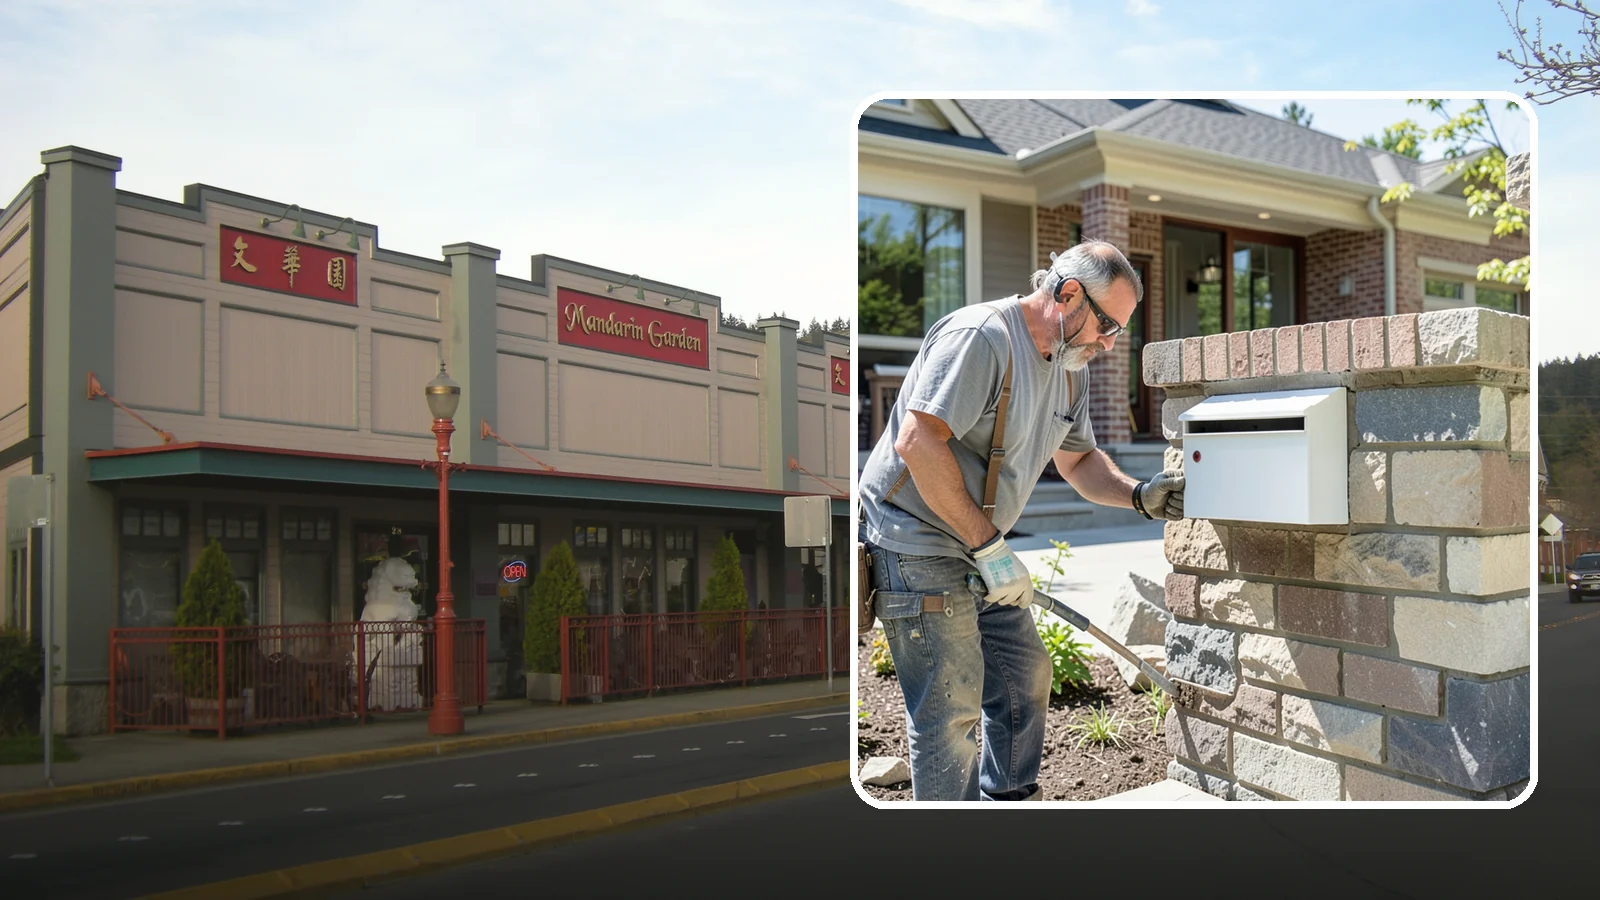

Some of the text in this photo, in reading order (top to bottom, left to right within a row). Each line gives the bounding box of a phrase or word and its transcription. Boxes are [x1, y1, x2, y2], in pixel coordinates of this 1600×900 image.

[231, 235, 346, 291] 文華園
[564, 302, 701, 352] Mandarin Garden
[503, 565, 527, 578] OPEN
